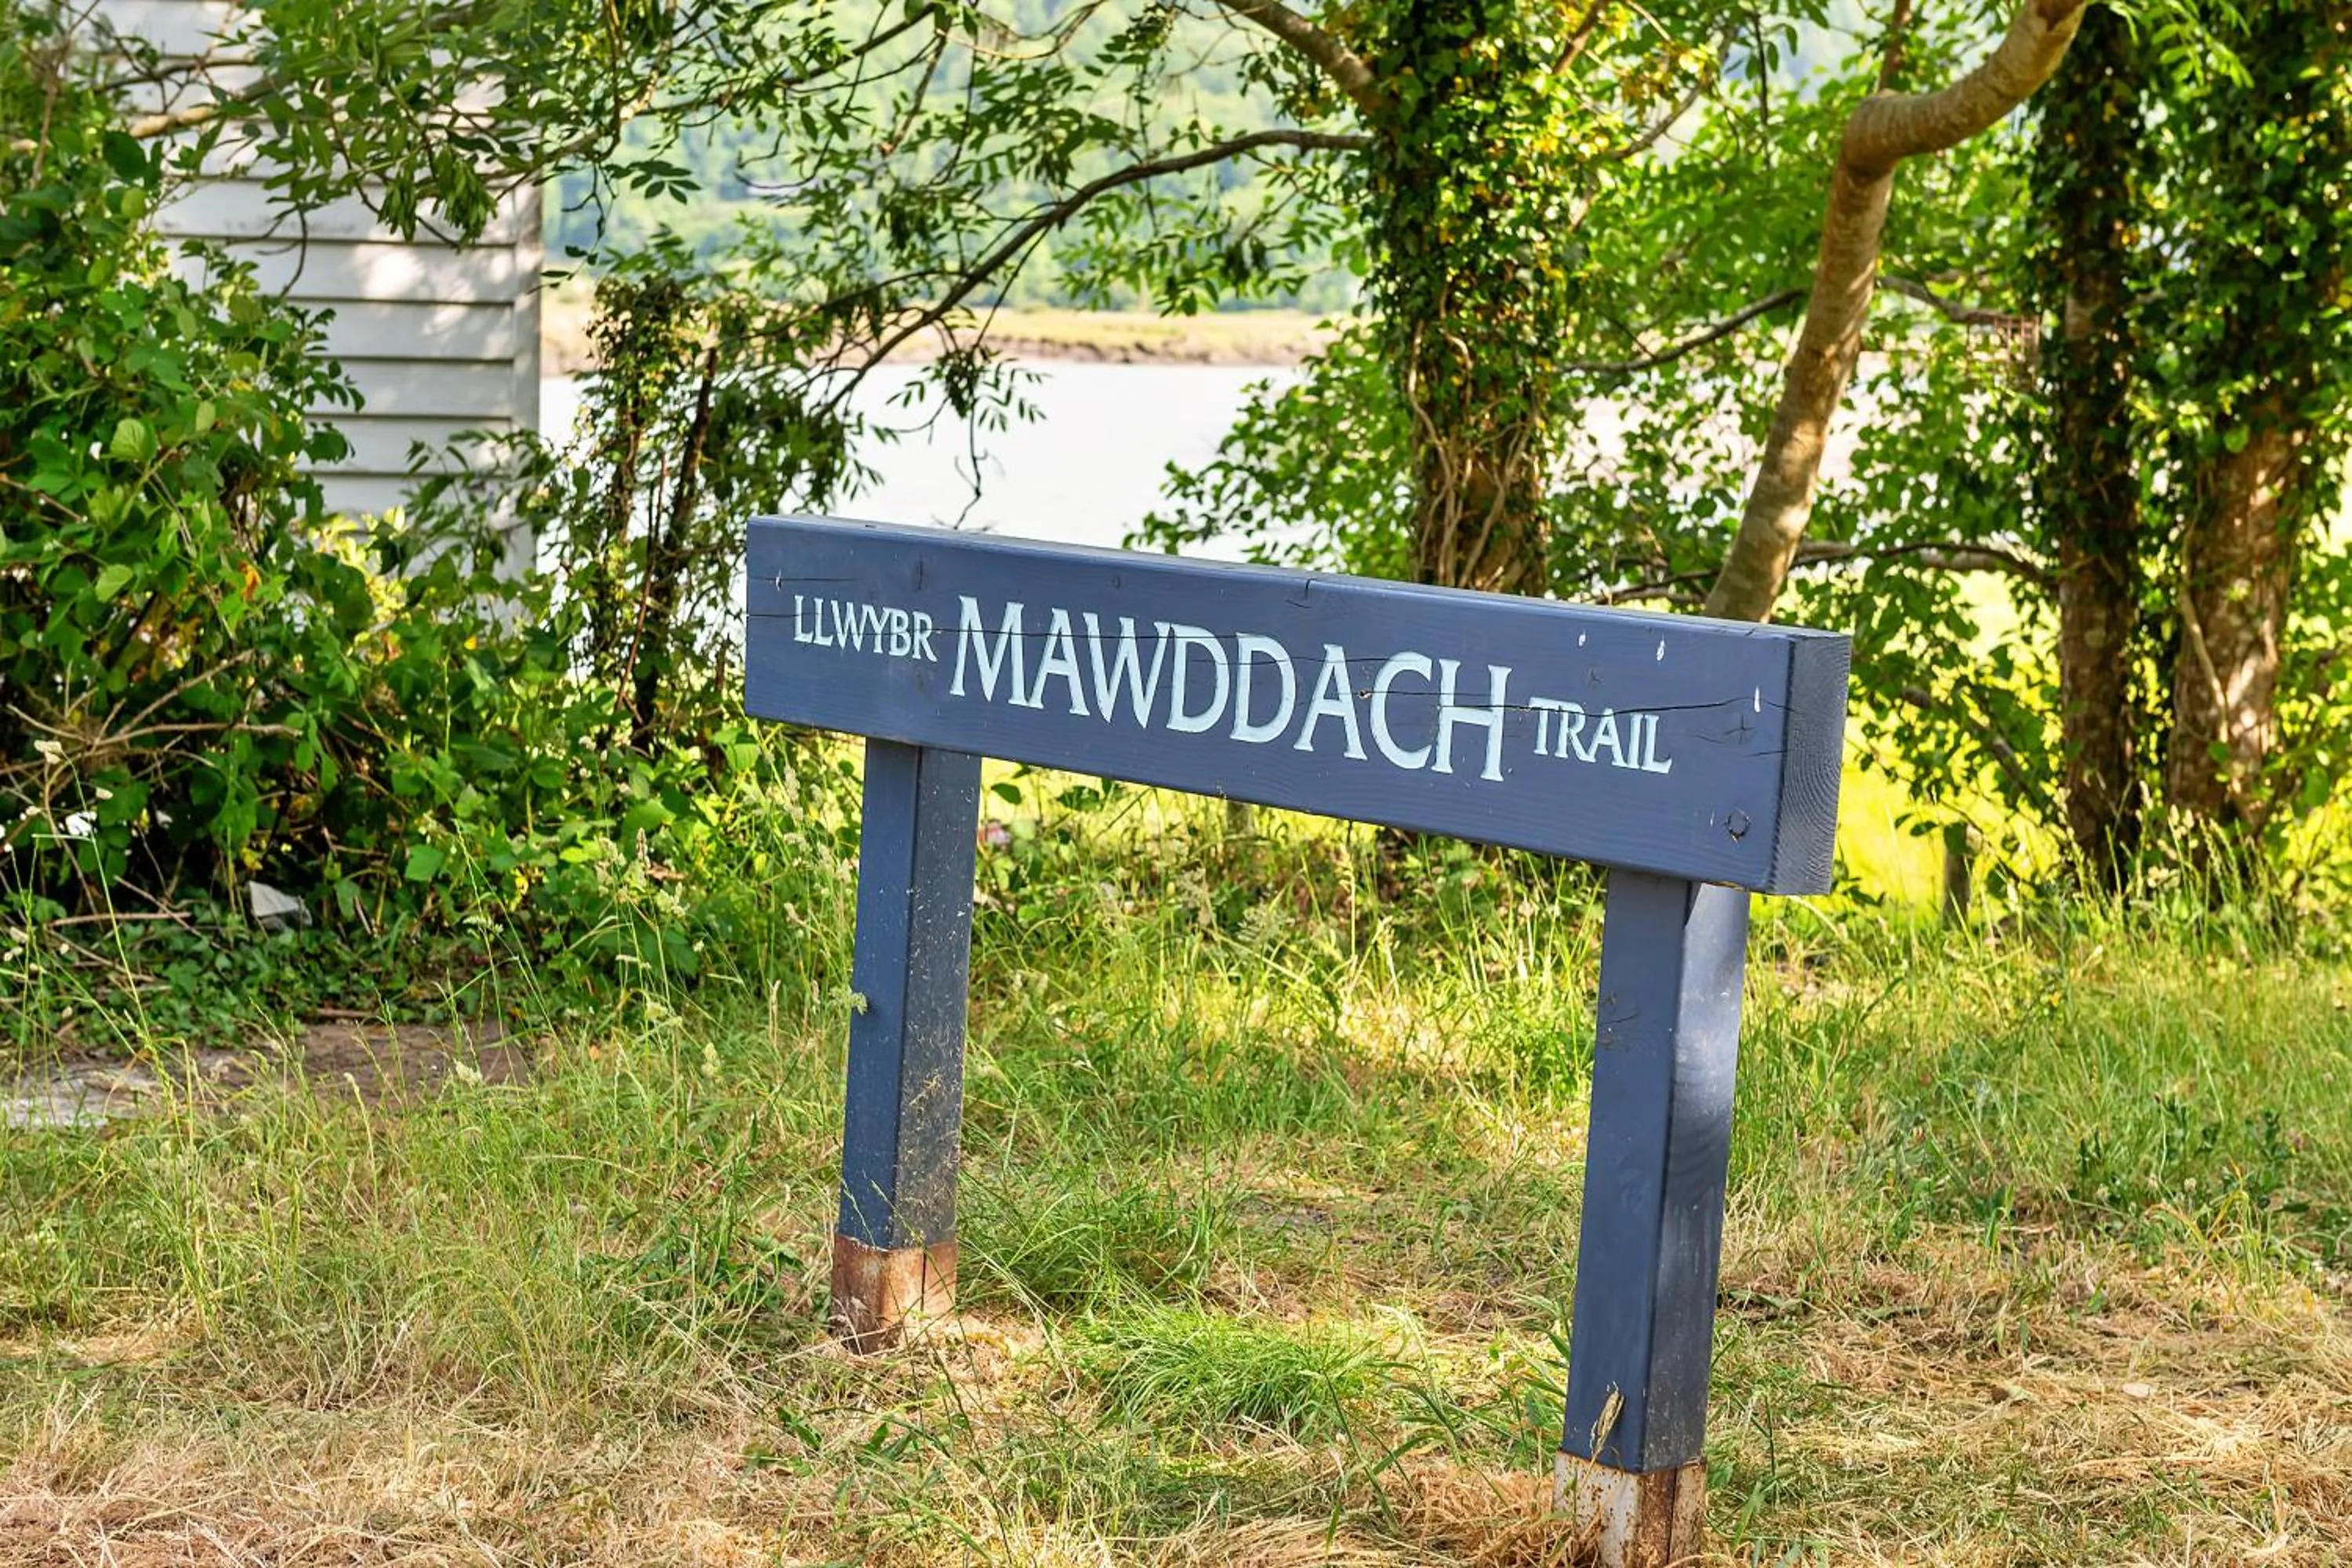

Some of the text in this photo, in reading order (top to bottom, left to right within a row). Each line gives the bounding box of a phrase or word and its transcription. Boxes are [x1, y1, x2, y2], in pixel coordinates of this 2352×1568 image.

[793, 594, 1672, 782] LLWYBR MAWDDACH TRAIL
